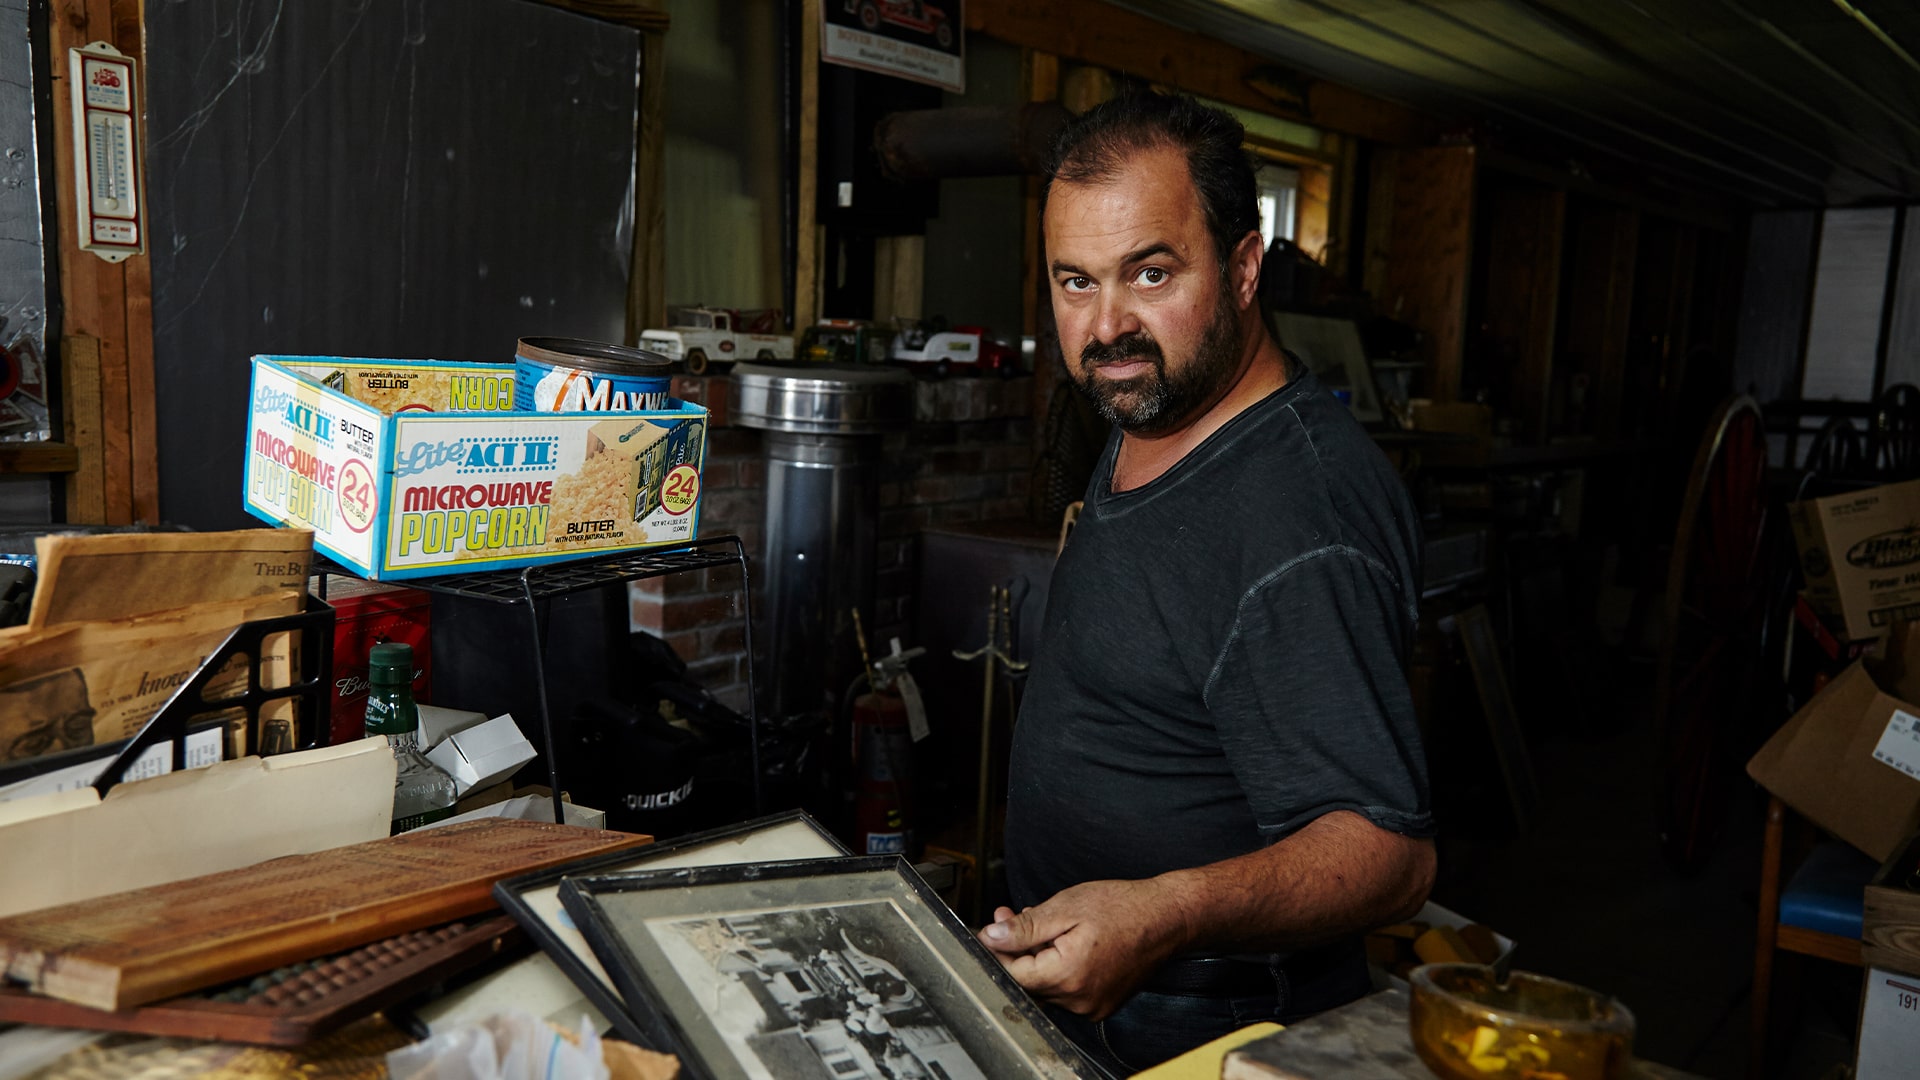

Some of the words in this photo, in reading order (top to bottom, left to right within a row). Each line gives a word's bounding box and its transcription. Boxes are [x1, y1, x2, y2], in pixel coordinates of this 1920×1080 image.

[368, 378, 409, 390] BUTTER
[255, 384, 287, 414] Lite
[285, 400, 313, 431] ACT
[340, 418, 375, 445] BUTTER
[256, 428, 335, 491] MICROWAVE
[393, 440, 467, 479] Lite
[464, 442, 518, 468] ACT
[520, 441, 552, 467] II
[253, 452, 334, 536] POPCORN
[343, 468, 370, 513] 24
[404, 480, 553, 513] MICROWAVE
[665, 472, 696, 498] 24
[399, 505, 550, 557] POPCORN
[566, 519, 615, 535] BUTTER
[568, 534, 584, 543] OTHER
[584, 533, 605, 541] NATURAL
[606, 531, 624, 539] FLAVOR
[254, 562, 286, 576] THE
